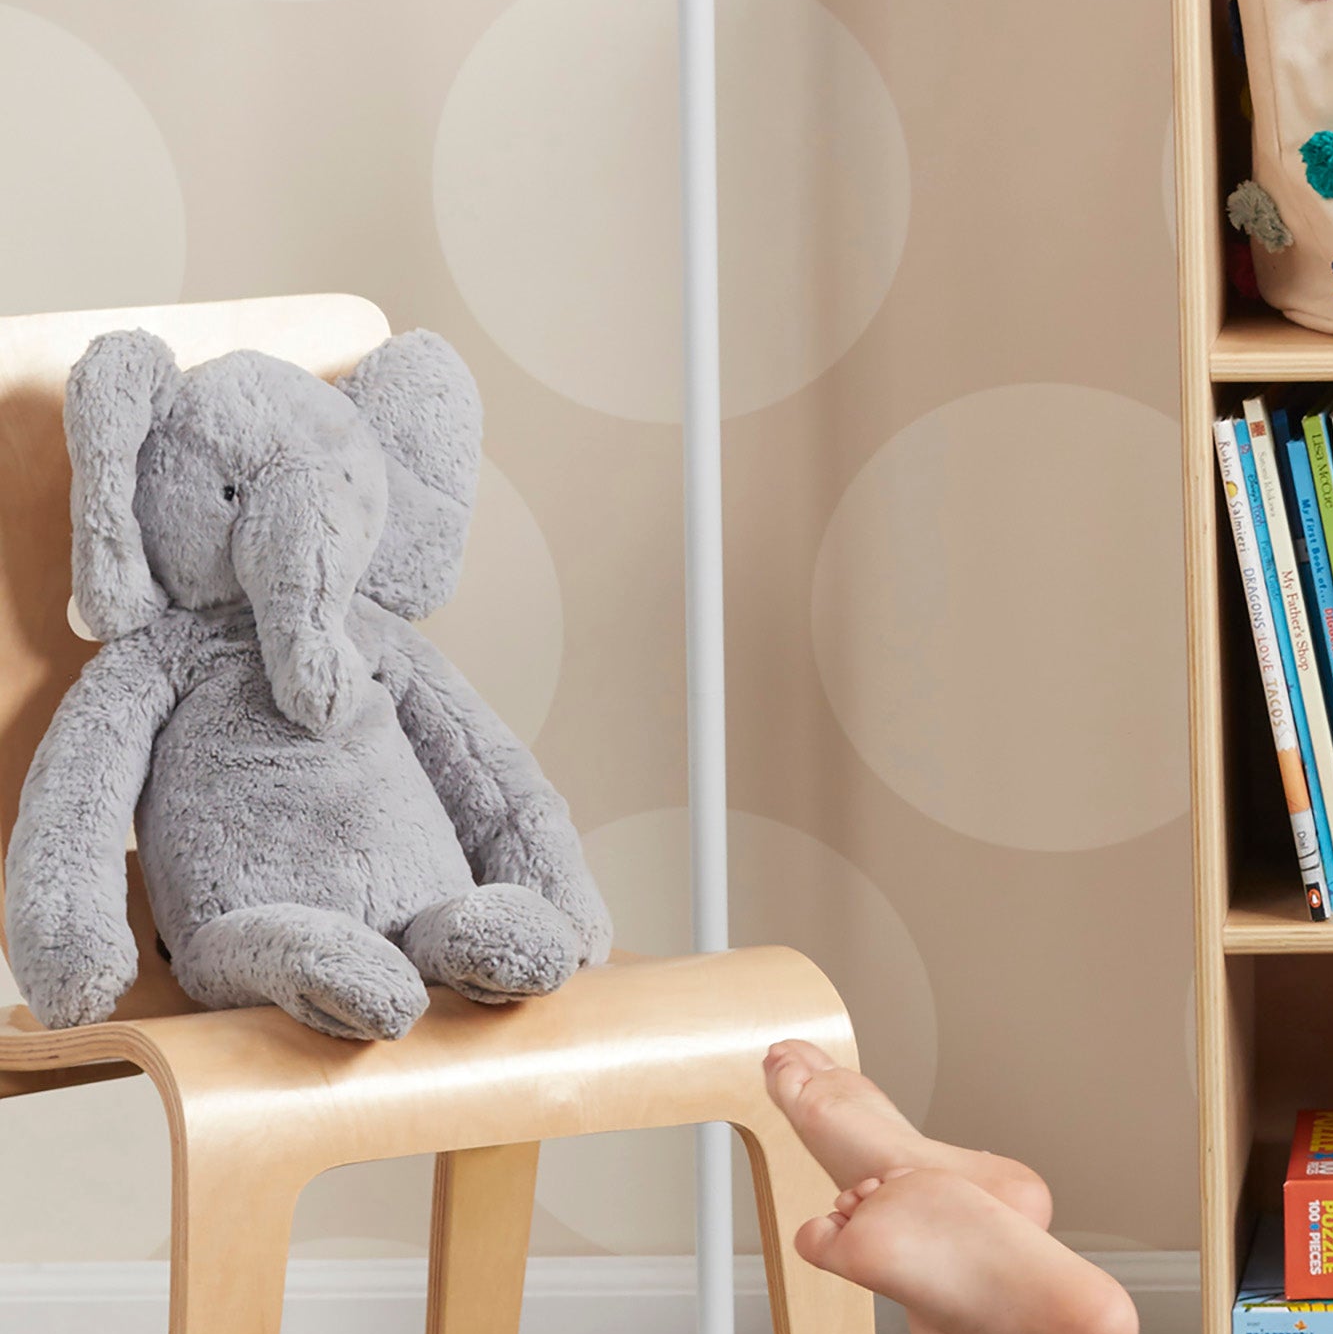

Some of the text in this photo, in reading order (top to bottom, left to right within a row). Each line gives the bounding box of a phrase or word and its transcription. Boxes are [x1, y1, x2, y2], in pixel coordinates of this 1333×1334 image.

[1311, 433, 1325, 462] Lisa
[1217, 440, 1246, 553] Rubin Salmieri
[1301, 498, 1311, 517] My
[1302, 517, 1315, 544] First
[1310, 545, 1323, 575] Book
[1281, 570, 1309, 672] My Father's Shop
[1243, 568, 1286, 728] DRAGONS LOVE TACOS
[1297, 832, 1309, 851] Dial
[1308, 1200, 1321, 1276] 100 PIECES
